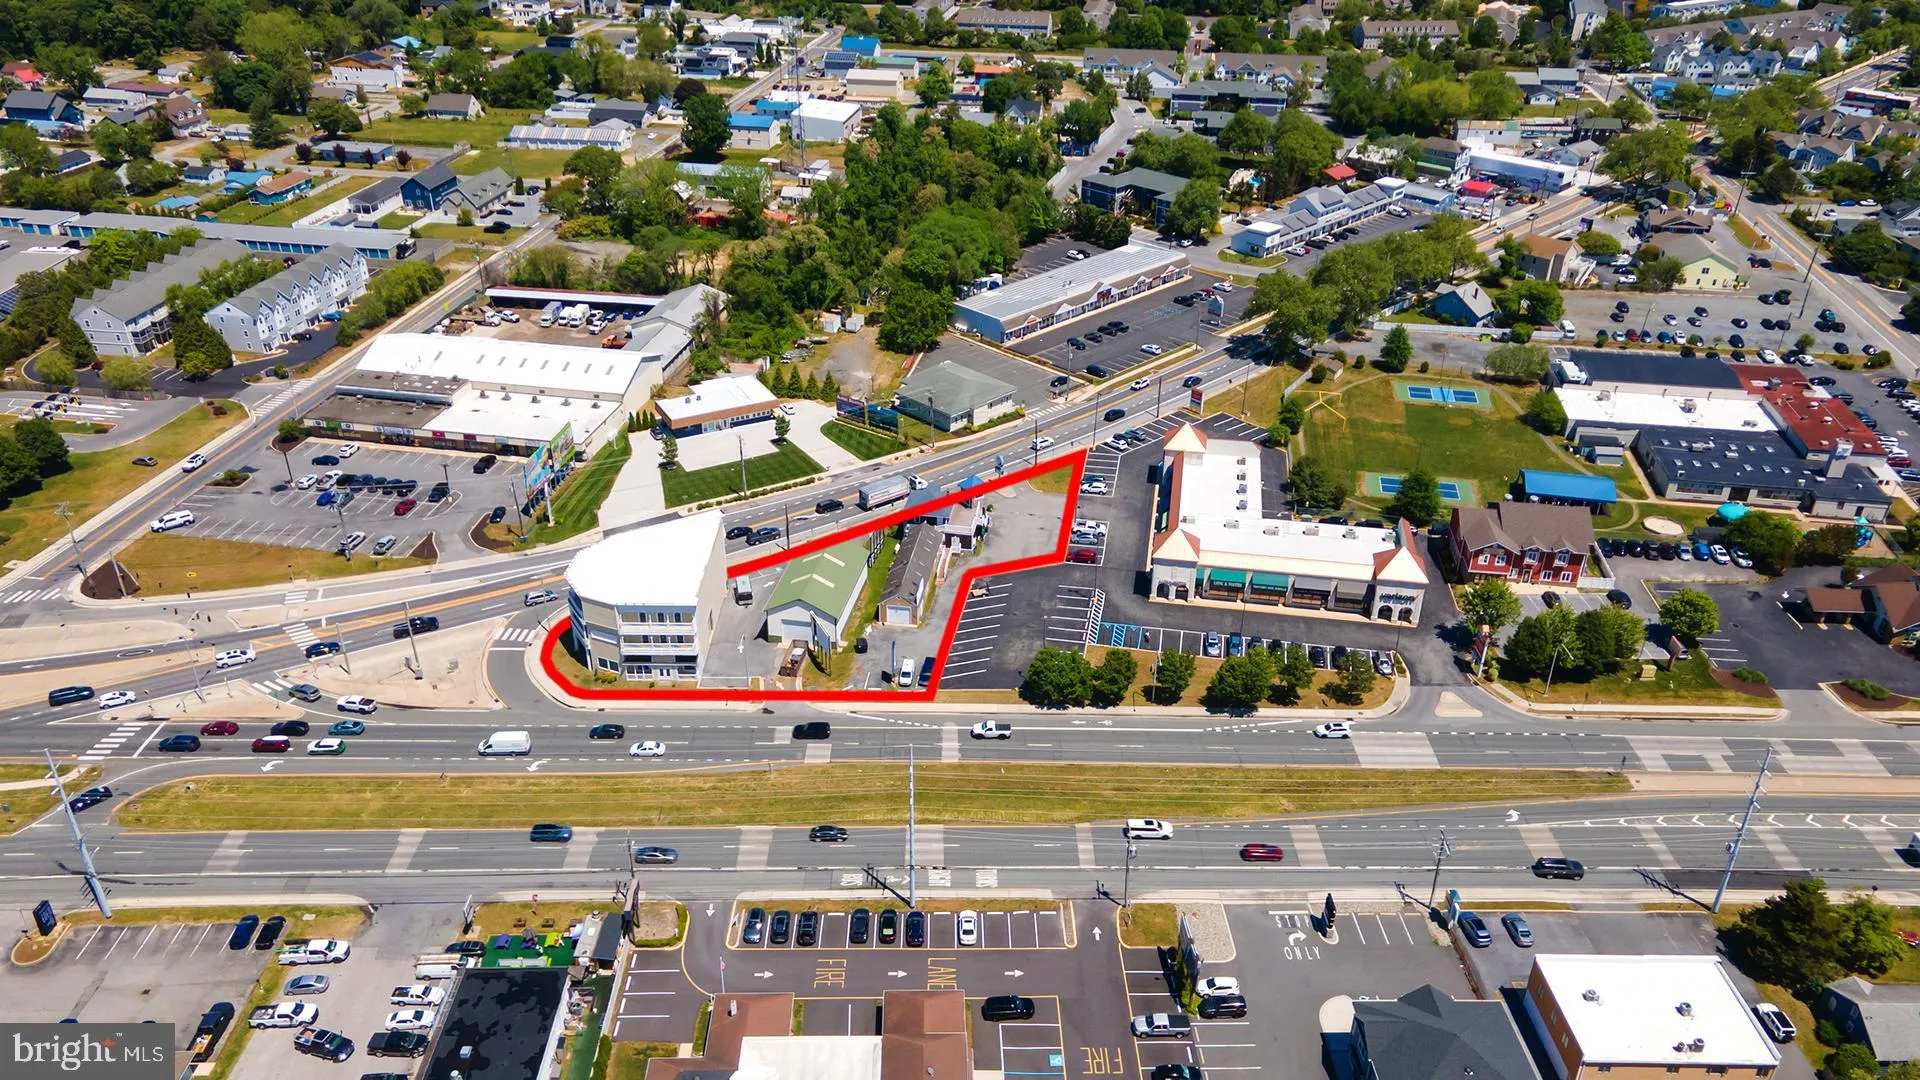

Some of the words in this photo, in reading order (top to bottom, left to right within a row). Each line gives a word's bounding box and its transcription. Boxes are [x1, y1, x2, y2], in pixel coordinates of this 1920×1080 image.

[1284, 946, 1320, 960] ONLY
[814, 959, 847, 989] FIRE
[928, 957, 957, 990] LANE
[1080, 1047, 1124, 1074] FIRE
